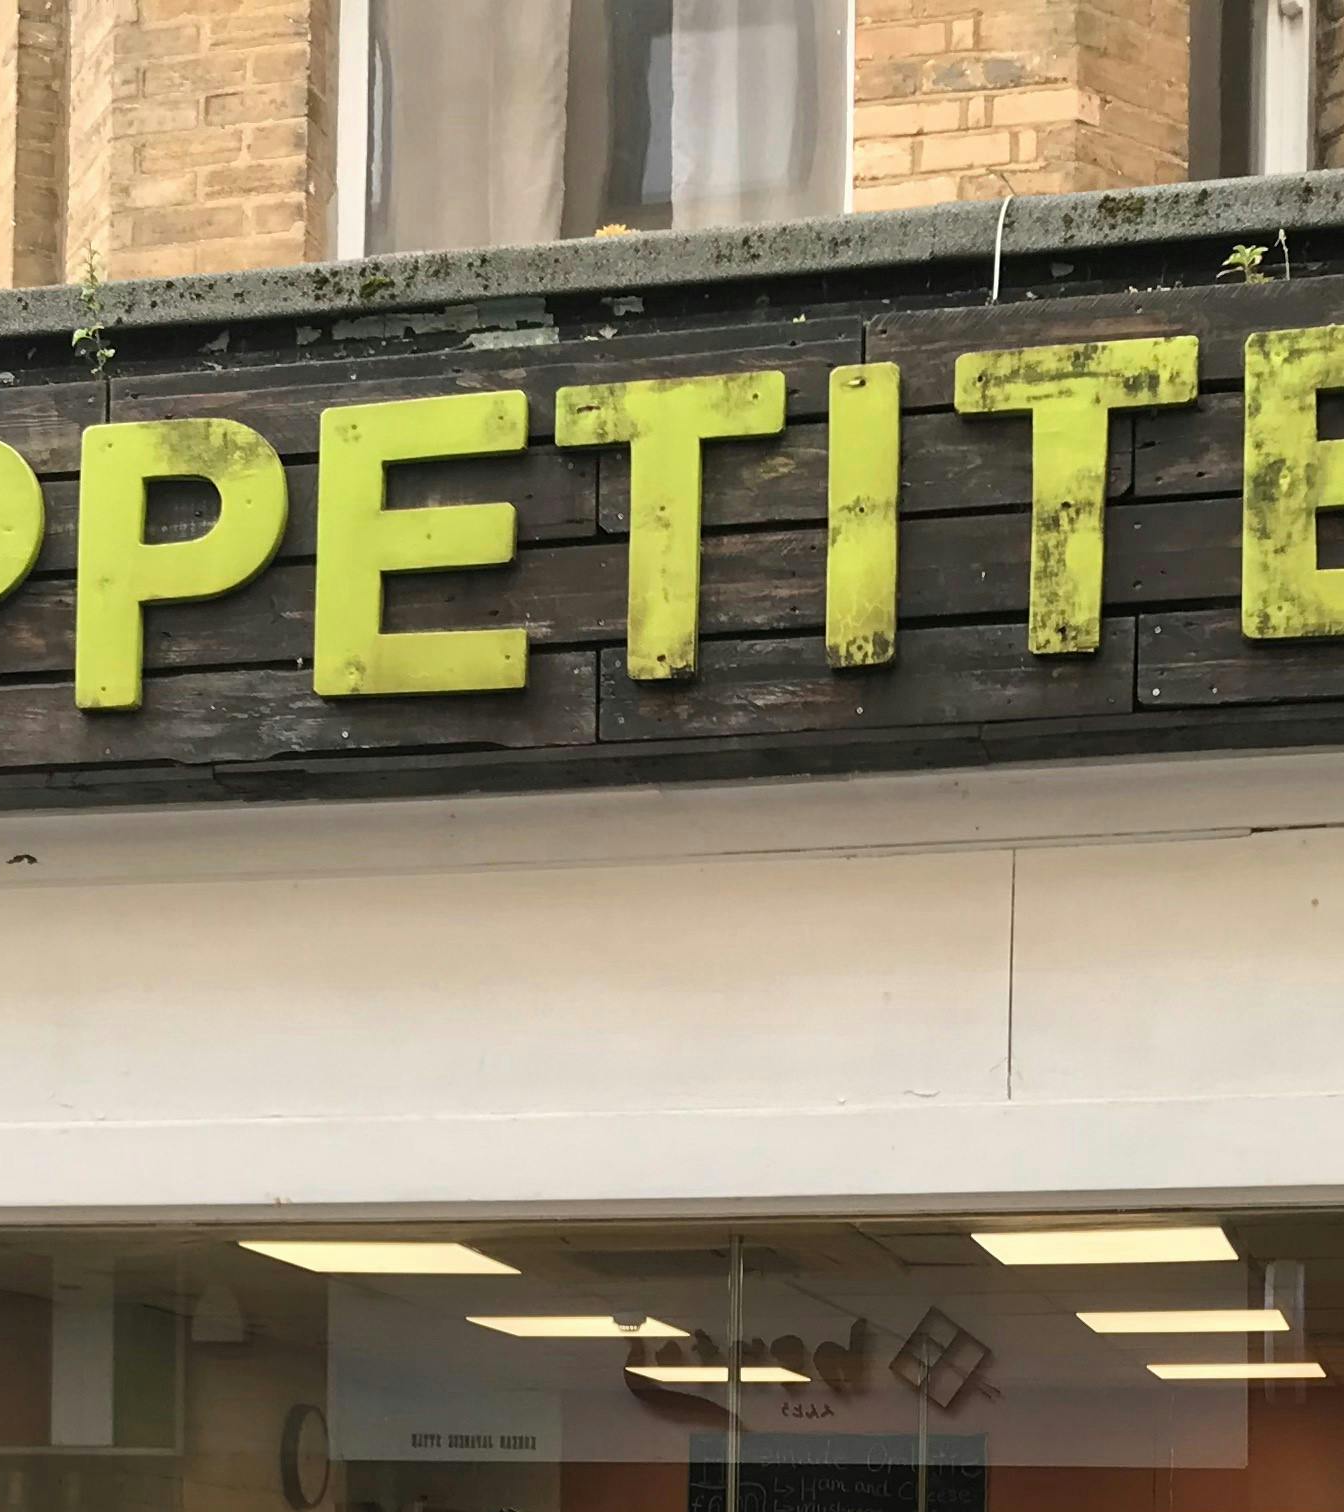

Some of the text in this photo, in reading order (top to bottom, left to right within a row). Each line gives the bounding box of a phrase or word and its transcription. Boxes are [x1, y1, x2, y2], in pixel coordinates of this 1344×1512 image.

[800, 1477, 973, 1504] Ham and Ceese
